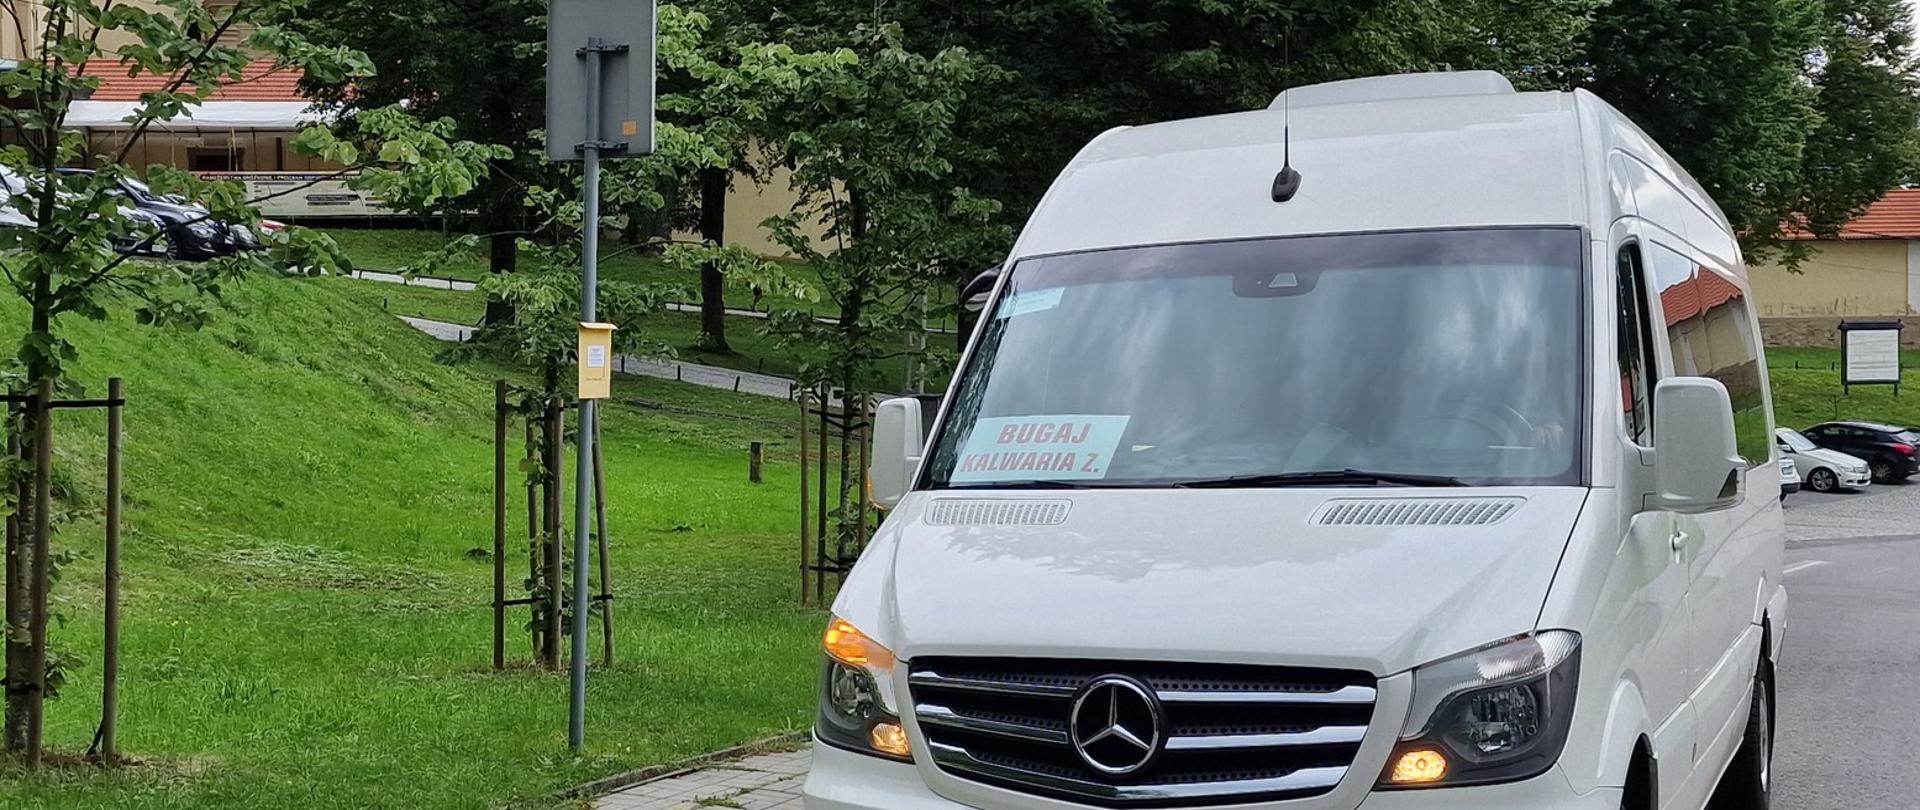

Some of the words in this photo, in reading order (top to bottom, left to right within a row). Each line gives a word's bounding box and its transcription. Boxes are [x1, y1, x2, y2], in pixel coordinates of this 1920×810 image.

[997, 423, 1092, 444] BUGAJ
[960, 452, 1076, 473] KALWARIA
[1080, 453, 1100, 473] Z.
